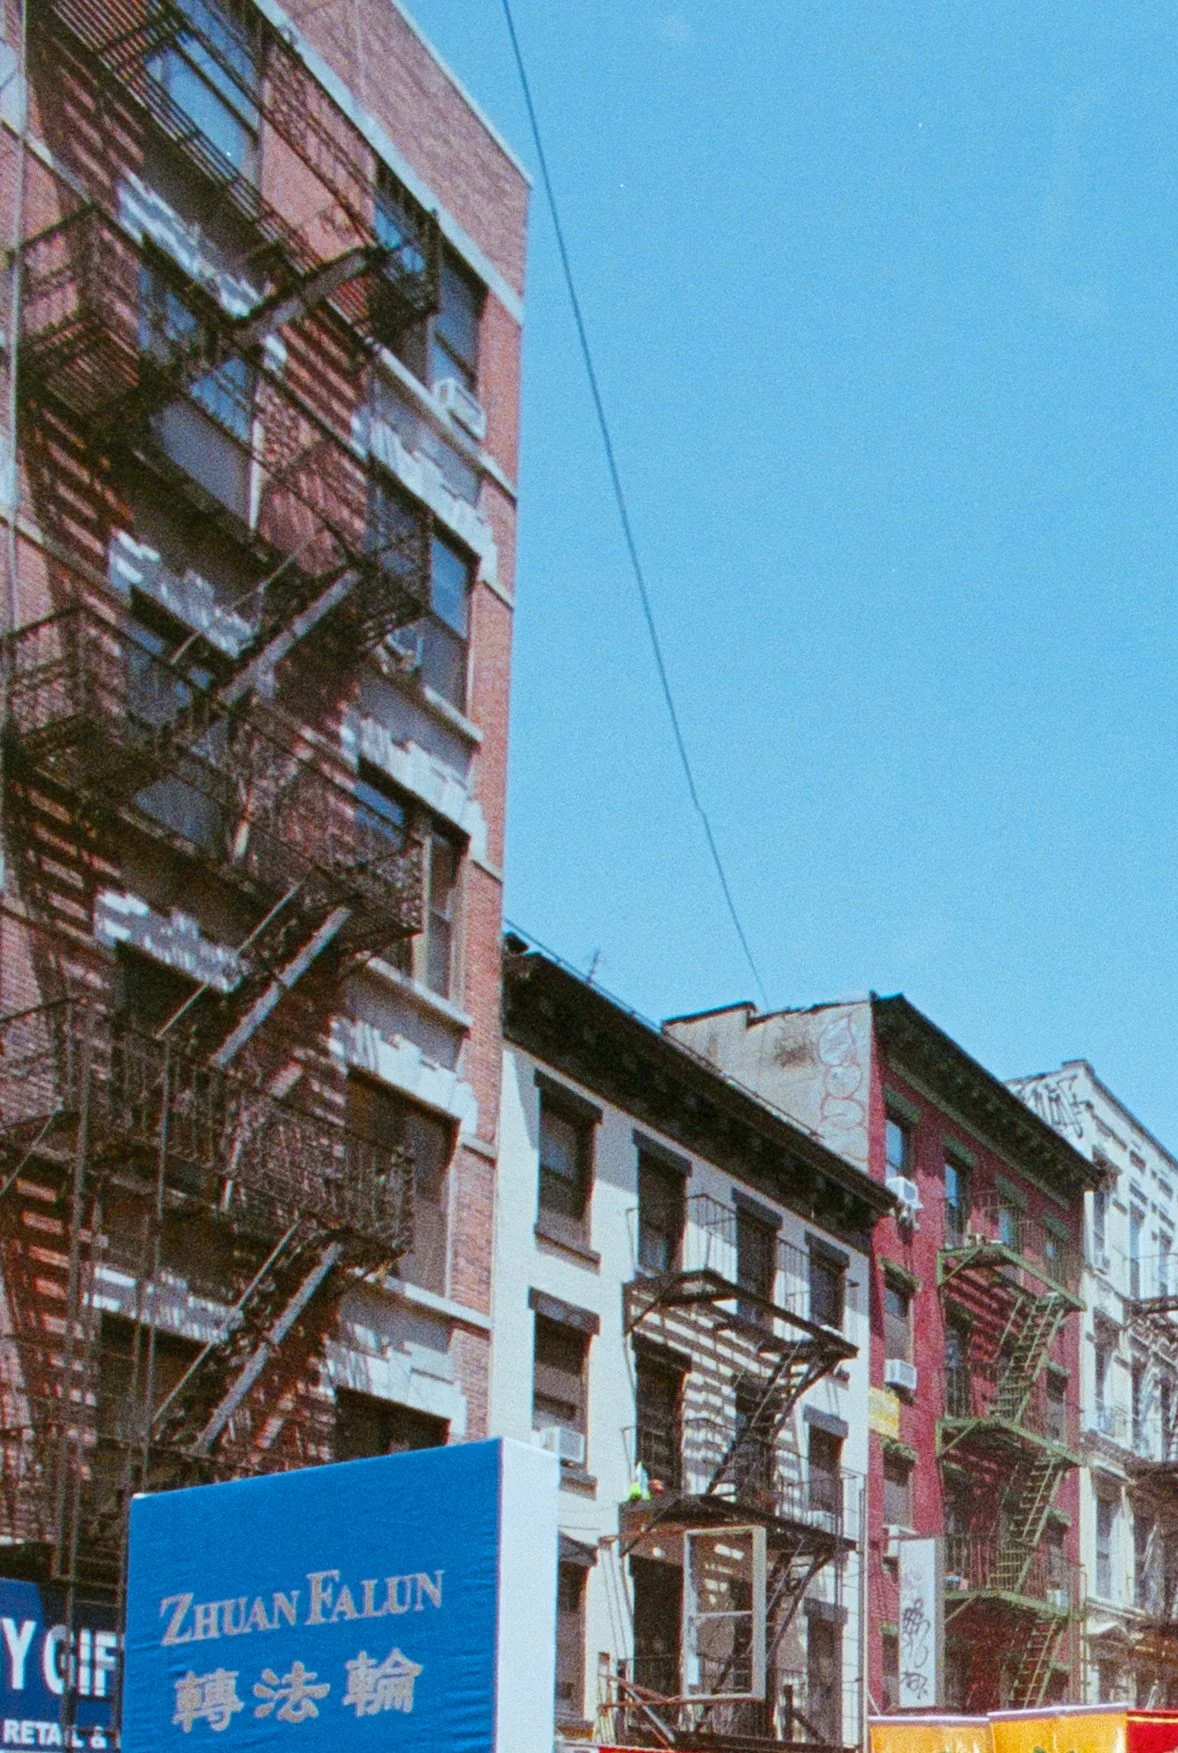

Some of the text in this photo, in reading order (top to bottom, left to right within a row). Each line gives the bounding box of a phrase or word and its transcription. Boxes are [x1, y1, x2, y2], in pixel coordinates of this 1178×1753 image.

[159, 1569, 446, 1647] ZHUAN FALUN
[42, 1624, 126, 1697] GIF
